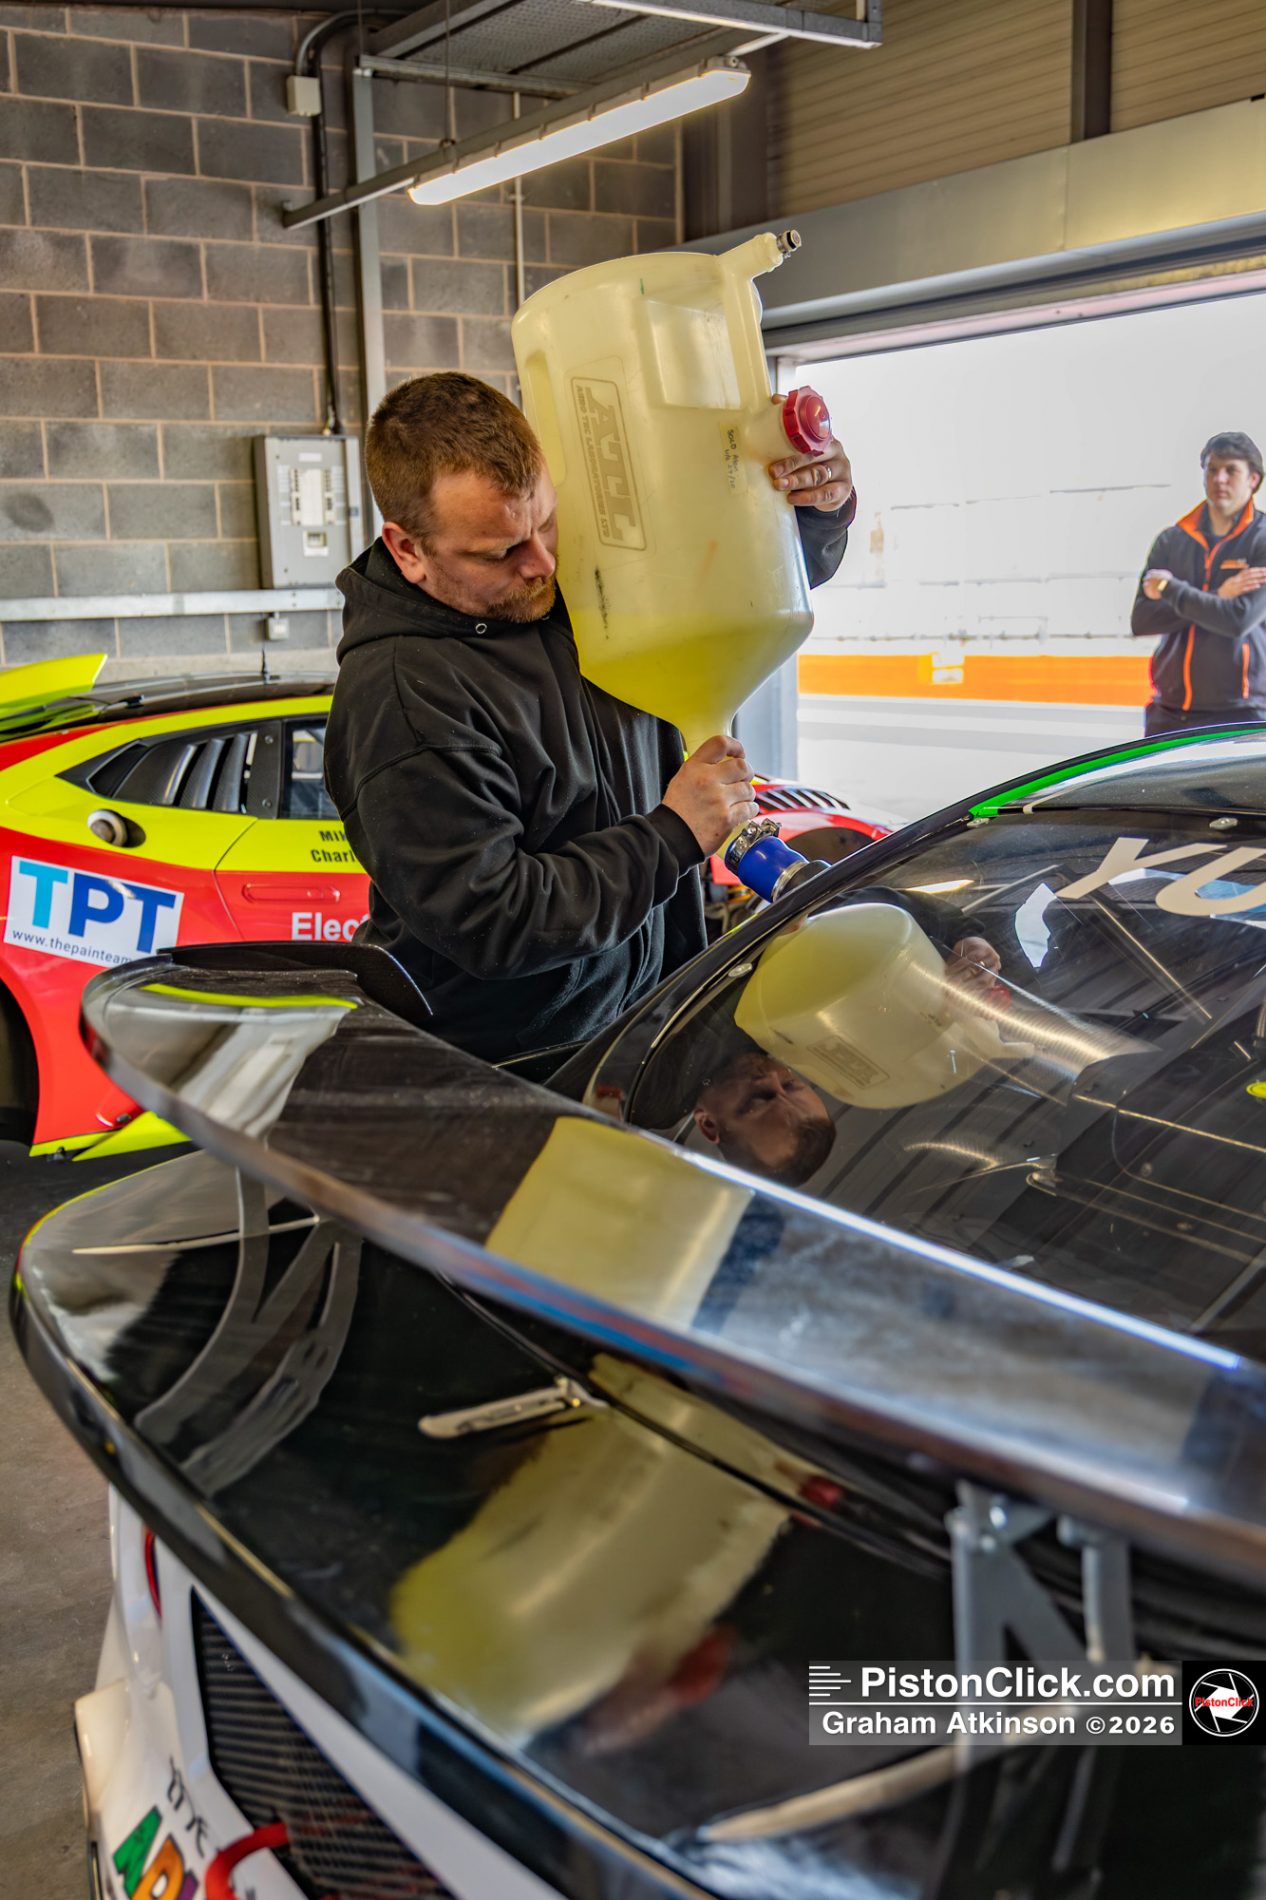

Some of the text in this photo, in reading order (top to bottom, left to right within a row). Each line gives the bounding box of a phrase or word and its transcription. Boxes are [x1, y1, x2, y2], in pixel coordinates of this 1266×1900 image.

[585, 386, 636, 541] ATL
[18, 860, 176, 954] TPT
[292, 911, 369, 942] Elec
